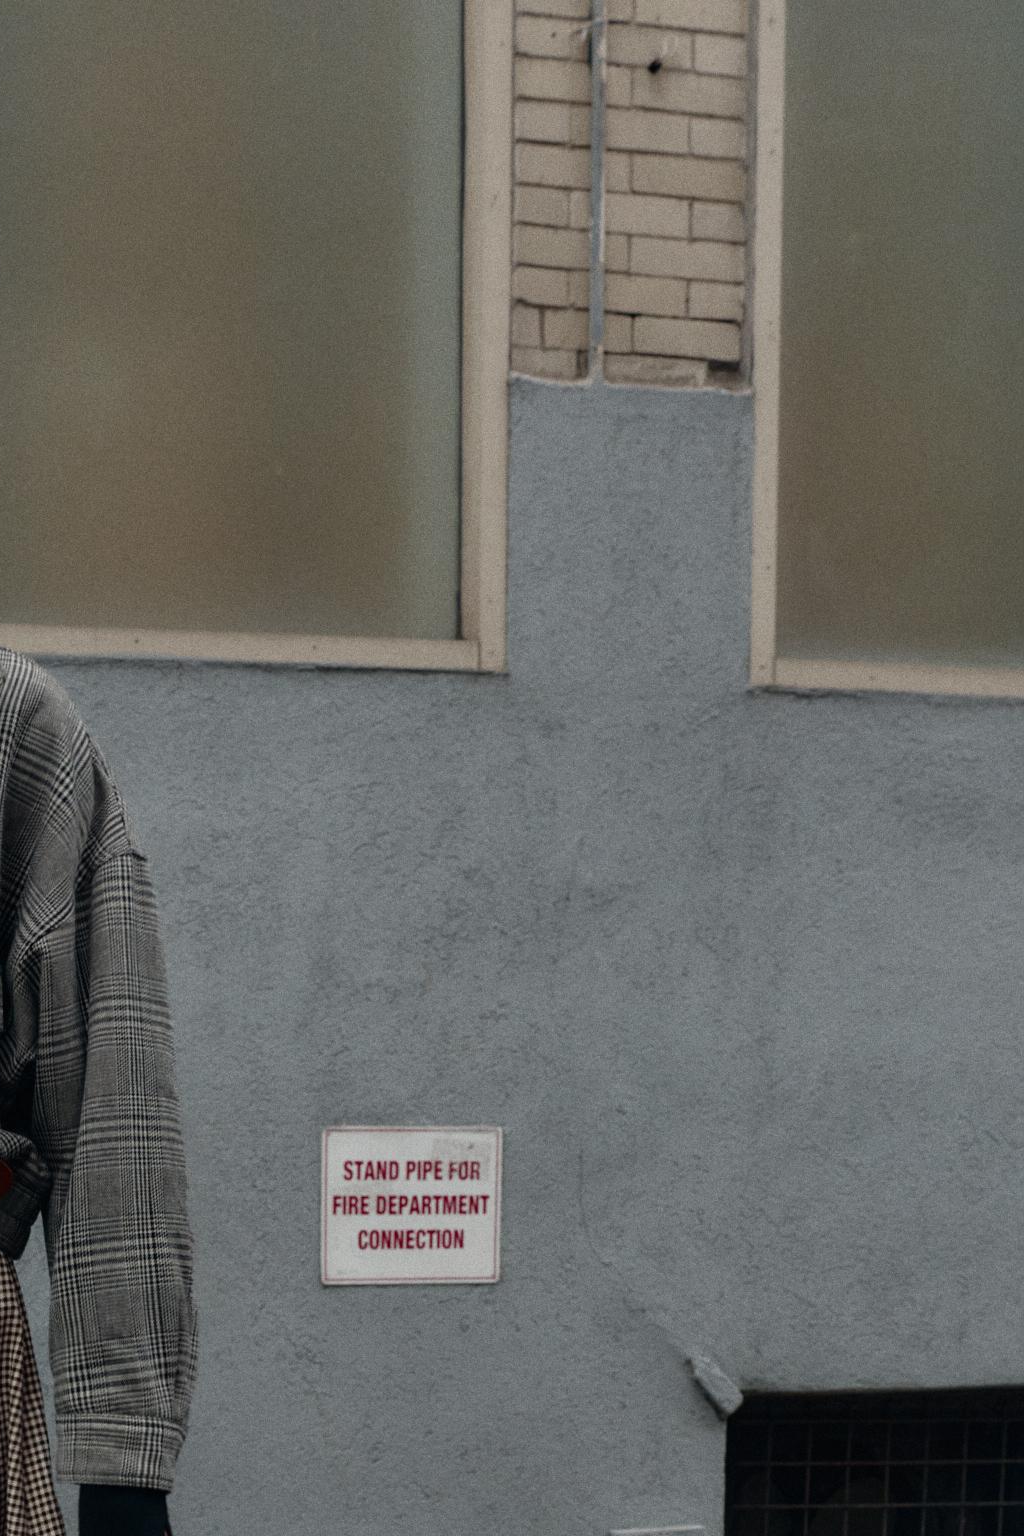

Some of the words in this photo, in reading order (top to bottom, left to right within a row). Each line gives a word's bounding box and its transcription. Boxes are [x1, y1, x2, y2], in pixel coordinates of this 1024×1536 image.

[343, 1160, 399, 1181] STAND
[406, 1160, 443, 1180] PIPE
[448, 1160, 480, 1180] FOR
[332, 1195, 370, 1215] FIRE
[376, 1195, 490, 1215] DEPARTMENT
[358, 1229, 464, 1250] CONNECTION
